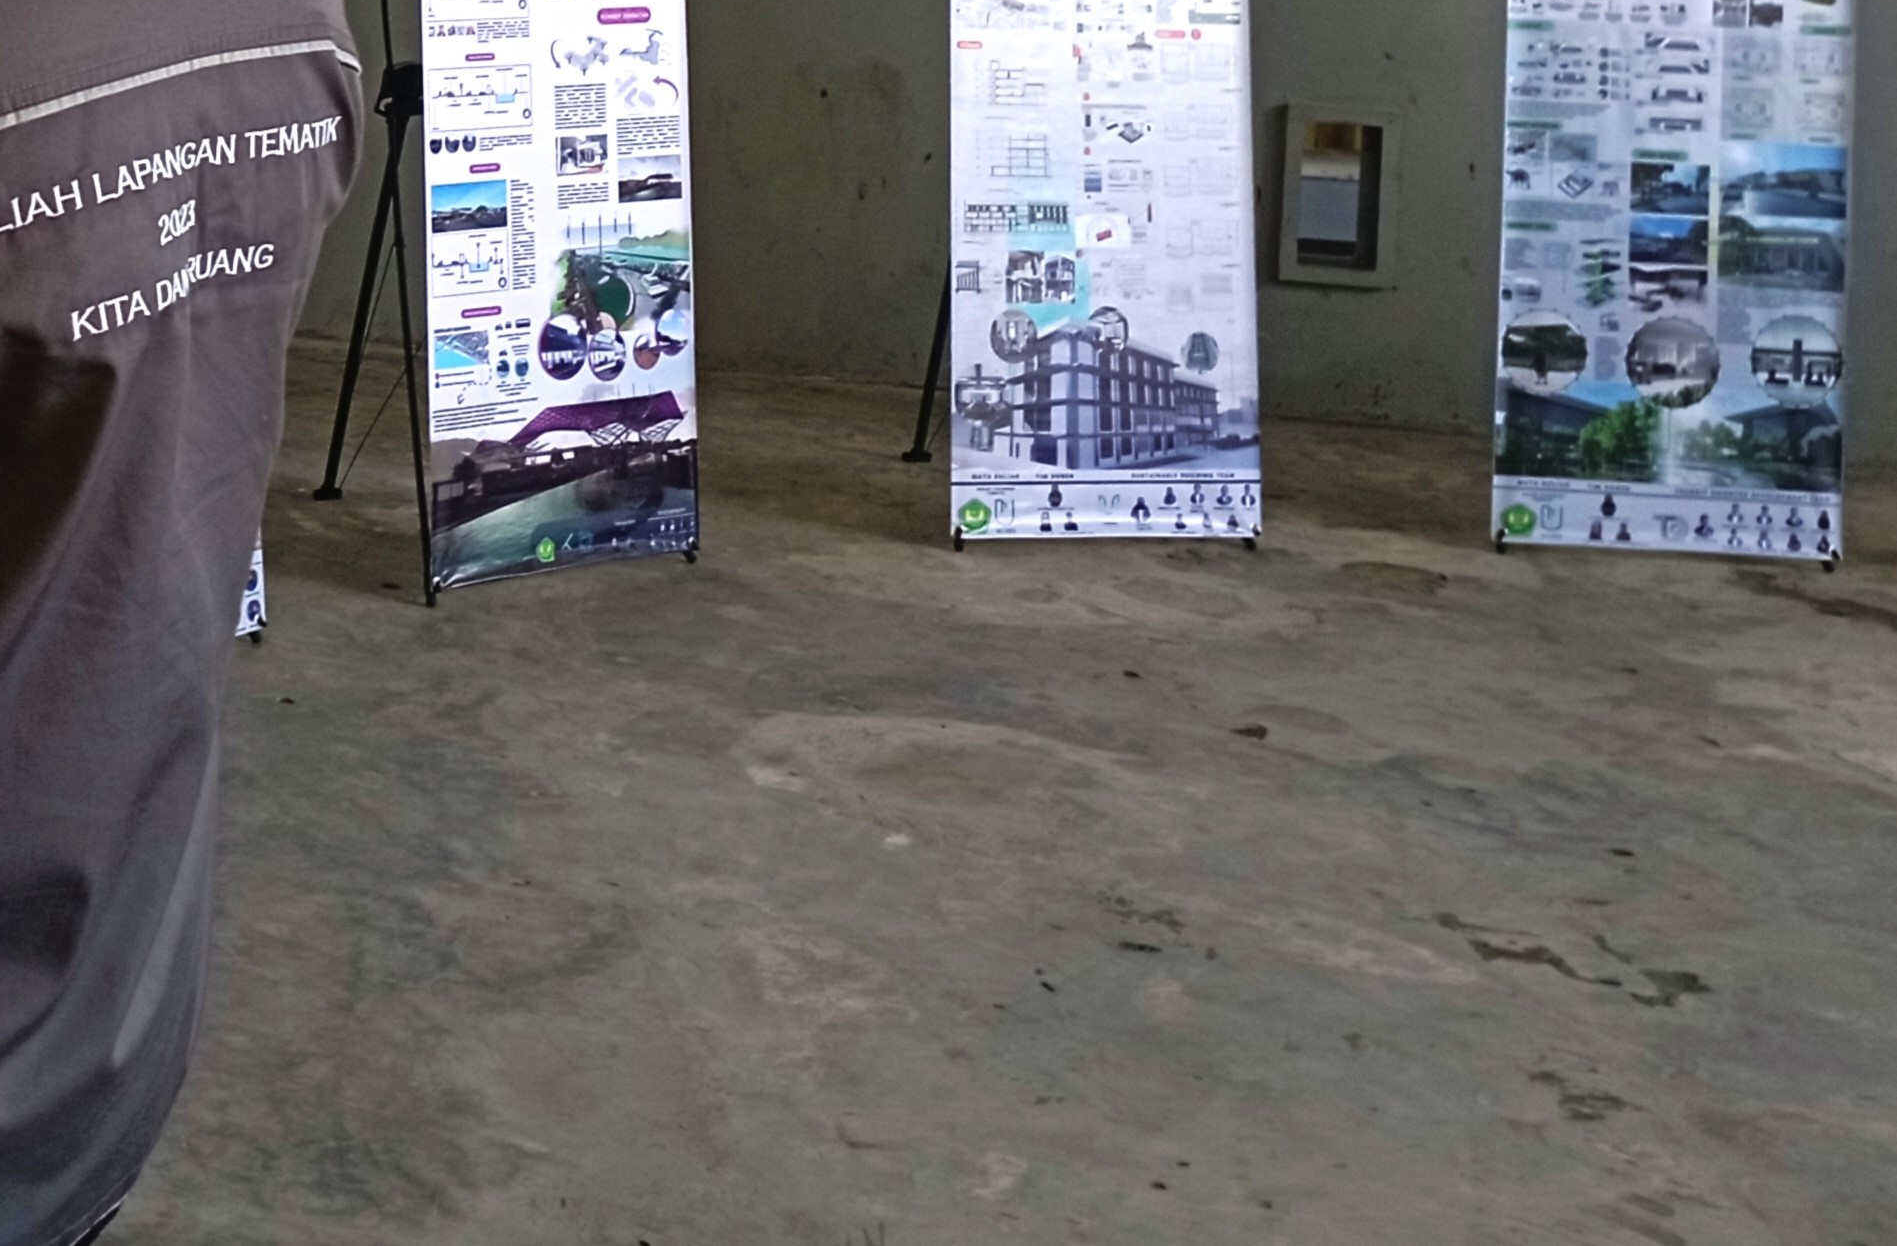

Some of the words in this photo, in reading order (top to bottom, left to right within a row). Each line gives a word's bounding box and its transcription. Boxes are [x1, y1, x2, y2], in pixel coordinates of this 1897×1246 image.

[91, 133, 237, 205] LAPANGAN
[244, 114, 343, 159] TEMATIK
[158, 199, 196, 246] 2023
[70, 290, 152, 342] KITA
[185, 243, 275, 283] RUANG
